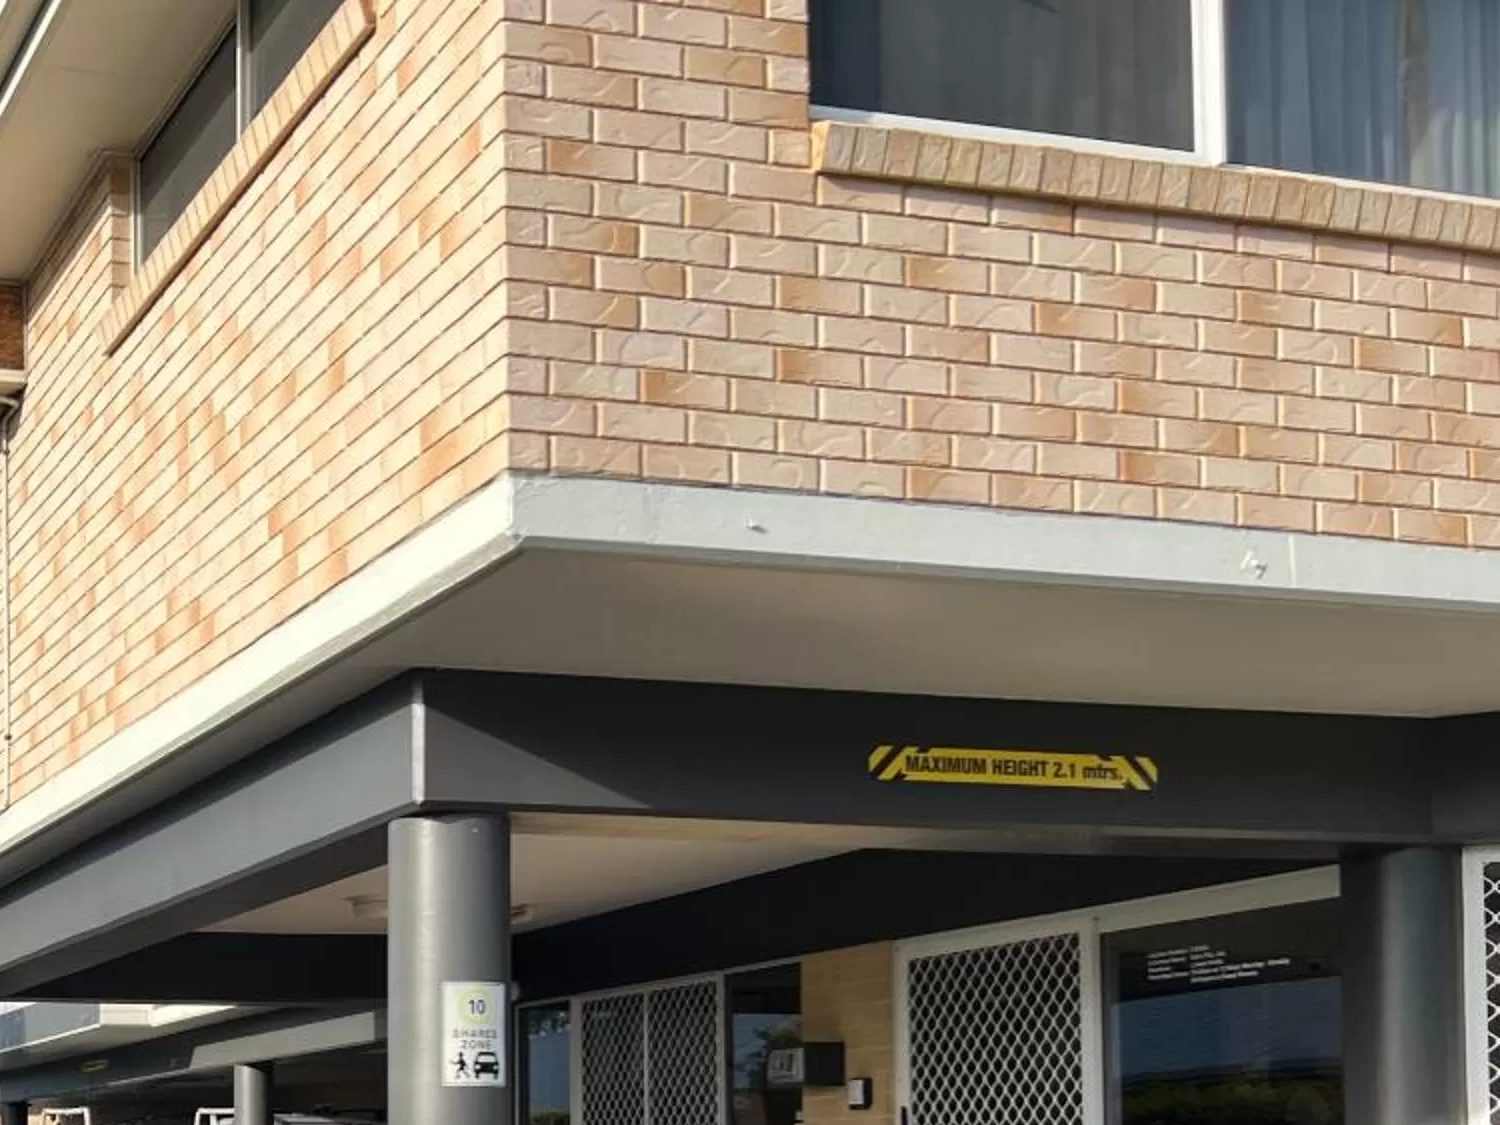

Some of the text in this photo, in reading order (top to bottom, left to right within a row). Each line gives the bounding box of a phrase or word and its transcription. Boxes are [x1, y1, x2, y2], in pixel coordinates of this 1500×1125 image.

[905, 755, 1123, 780] MAXIMUM HEIGHT 2.1 mtrs.
[468, 999, 486, 1015] 10
